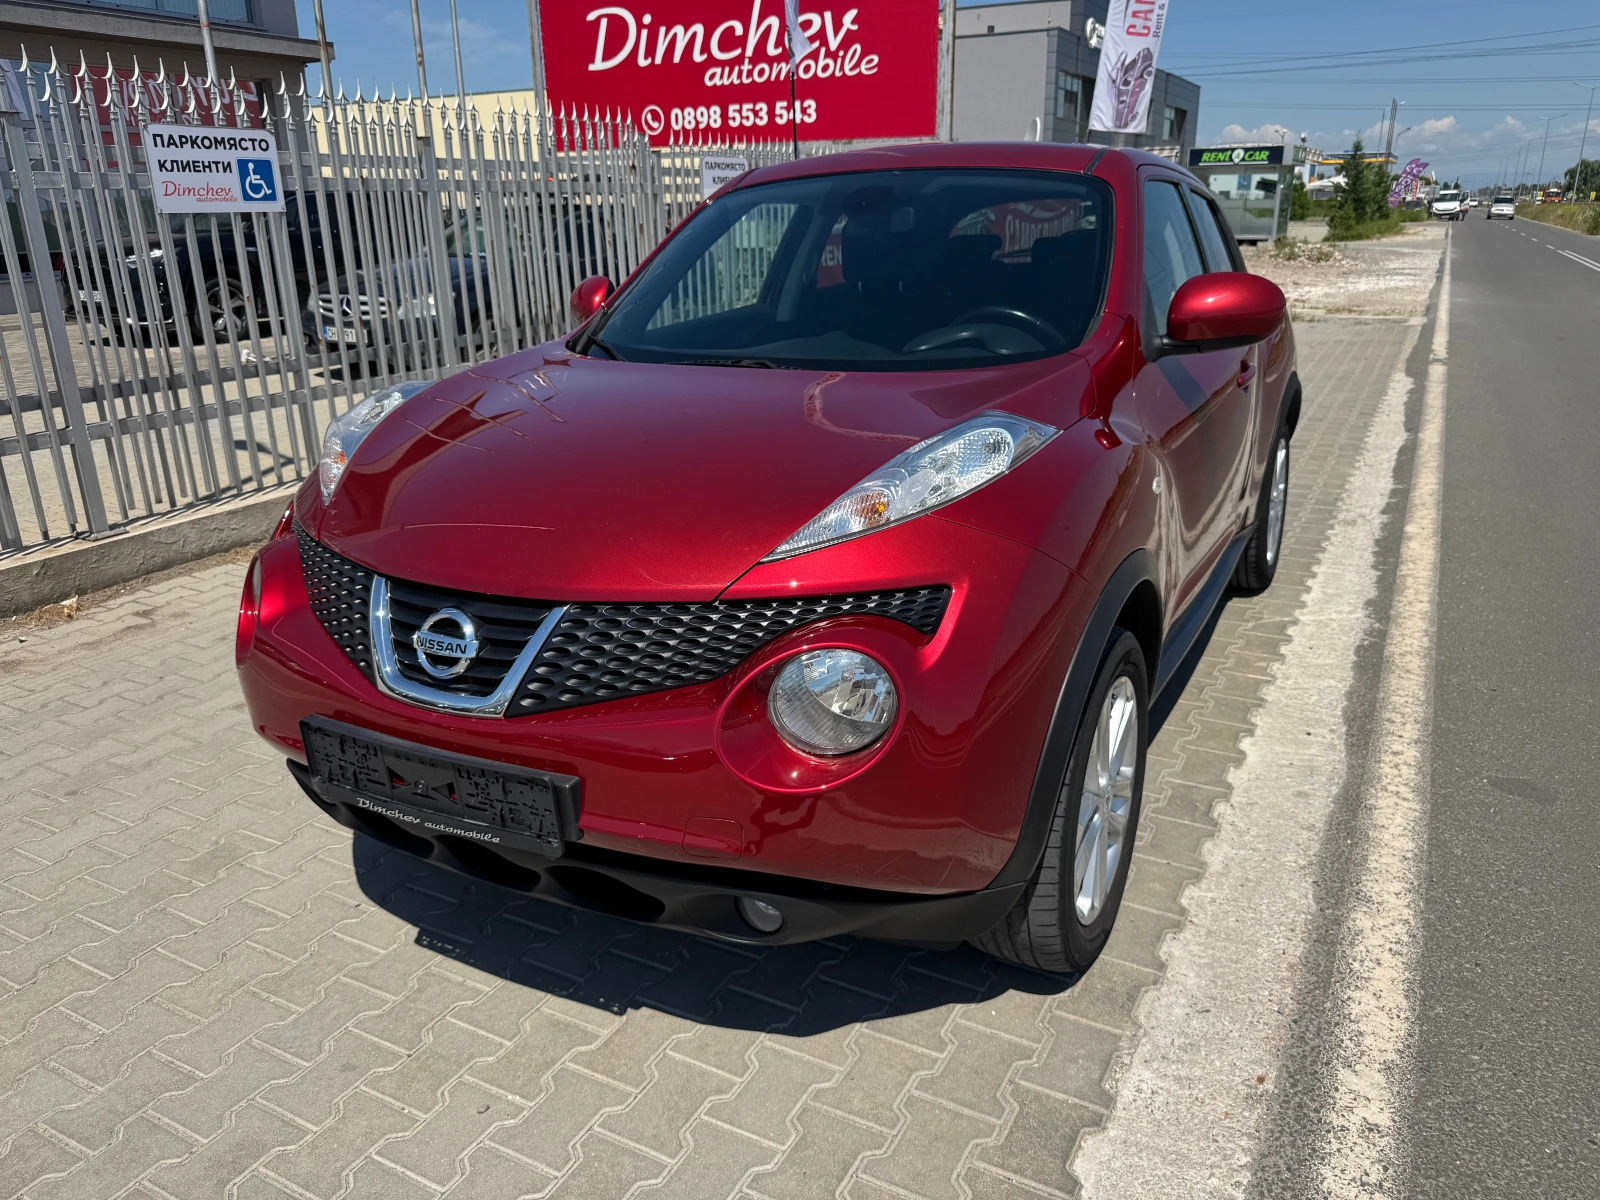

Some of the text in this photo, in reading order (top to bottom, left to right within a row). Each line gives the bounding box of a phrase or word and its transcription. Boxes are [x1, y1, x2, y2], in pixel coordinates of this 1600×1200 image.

[1152, 13, 1164, 37] Rent
[585, 0, 859, 72] Dimchev
[703, 43, 880, 87] automobile
[670, 99, 817, 131] 0898 553 543
[151, 133, 270, 152] ПАРКОМЯСТО
[1244, 150, 1270, 161] CAR
[157, 159, 233, 174] КЛИЕНТИ
[704, 161, 746, 172] ПАРКОМЯСТО
[161, 180, 233, 197] Dimchev
[196, 195, 238, 203] automobile
[418, 637, 467, 655] NISSAN
[356, 797, 500, 843] Dimchev automobile
